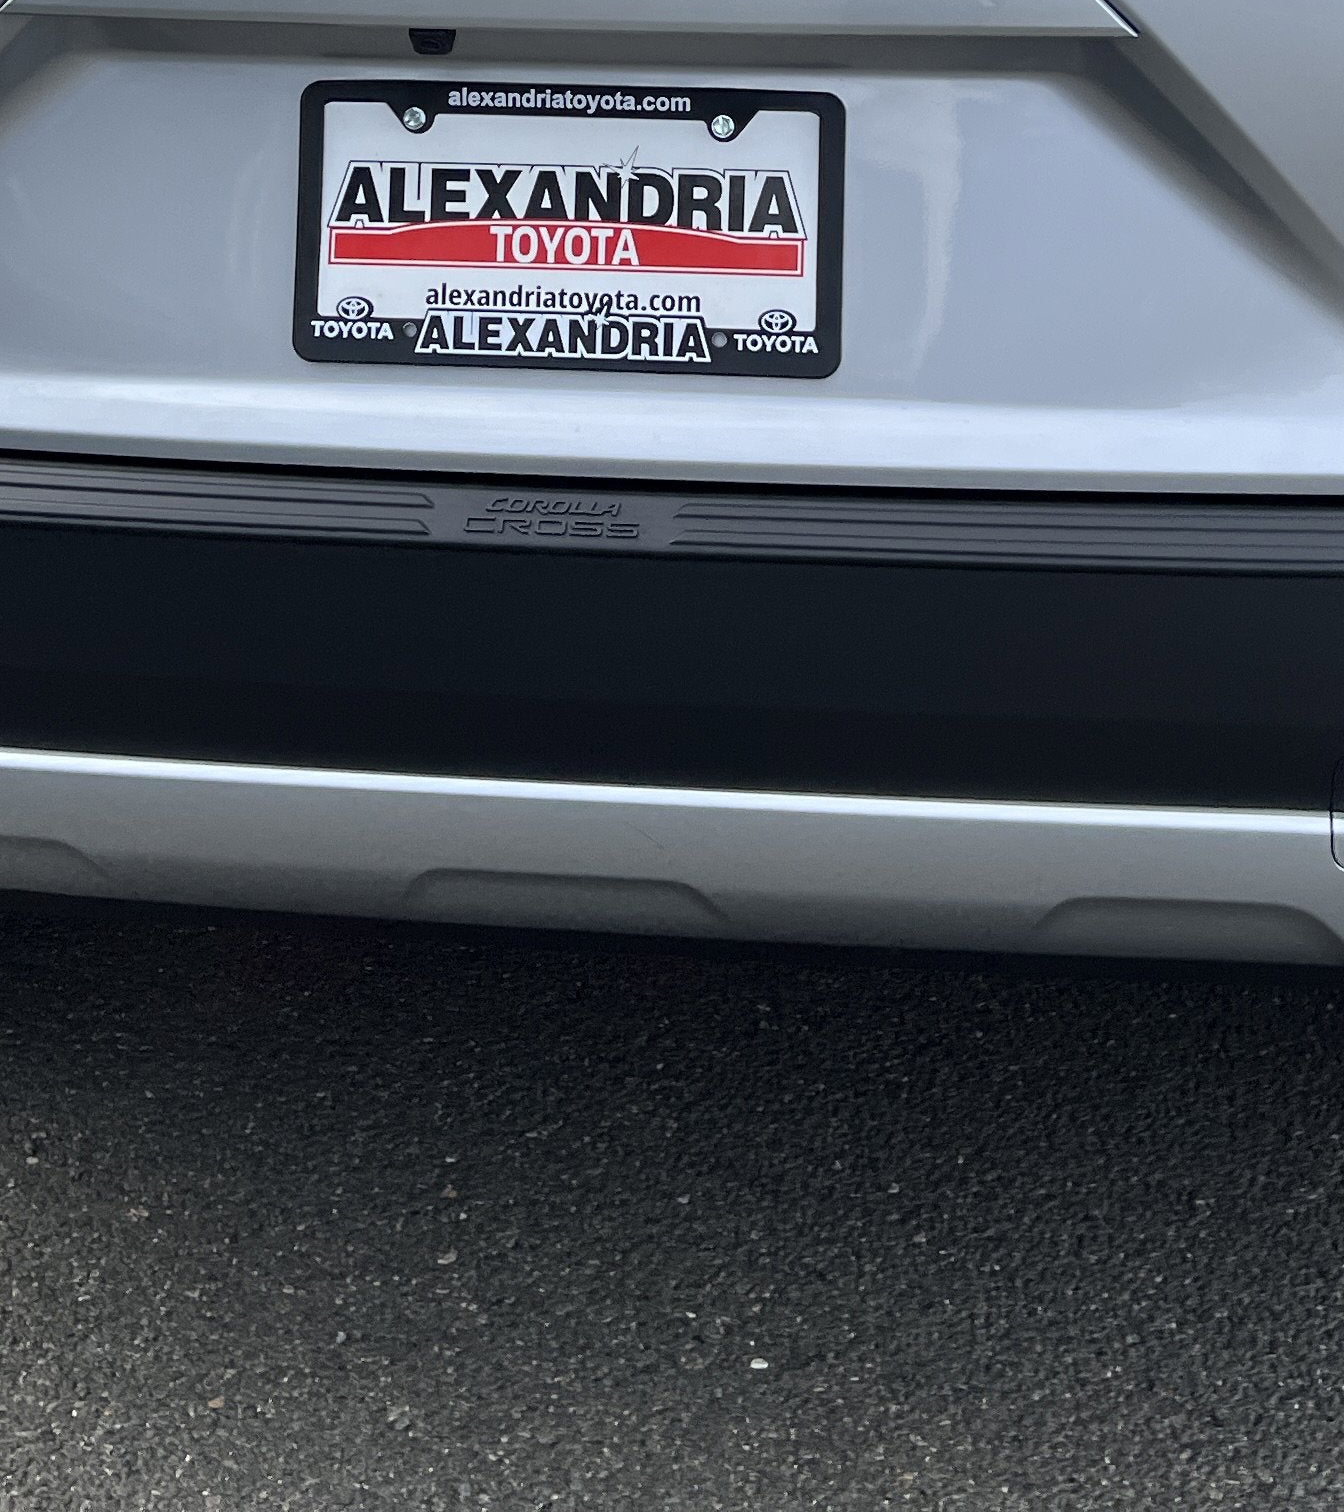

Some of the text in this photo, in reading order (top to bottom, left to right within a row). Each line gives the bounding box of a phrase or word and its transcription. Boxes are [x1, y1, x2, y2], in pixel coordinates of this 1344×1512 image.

[448, 88, 692, 113] alexandriatoyota.com
[334, 165, 800, 235] ALEXANDRIA
[489, 225, 641, 267] TOYOTA
[424, 282, 702, 314] alexandriatoyota.com
[311, 320, 394, 341] TOYOTA
[419, 314, 708, 358] ALEXANDRIA
[733, 334, 819, 354] TOYOTA
[485, 498, 622, 517] COROLLA
[464, 517, 640, 539] CROSS
